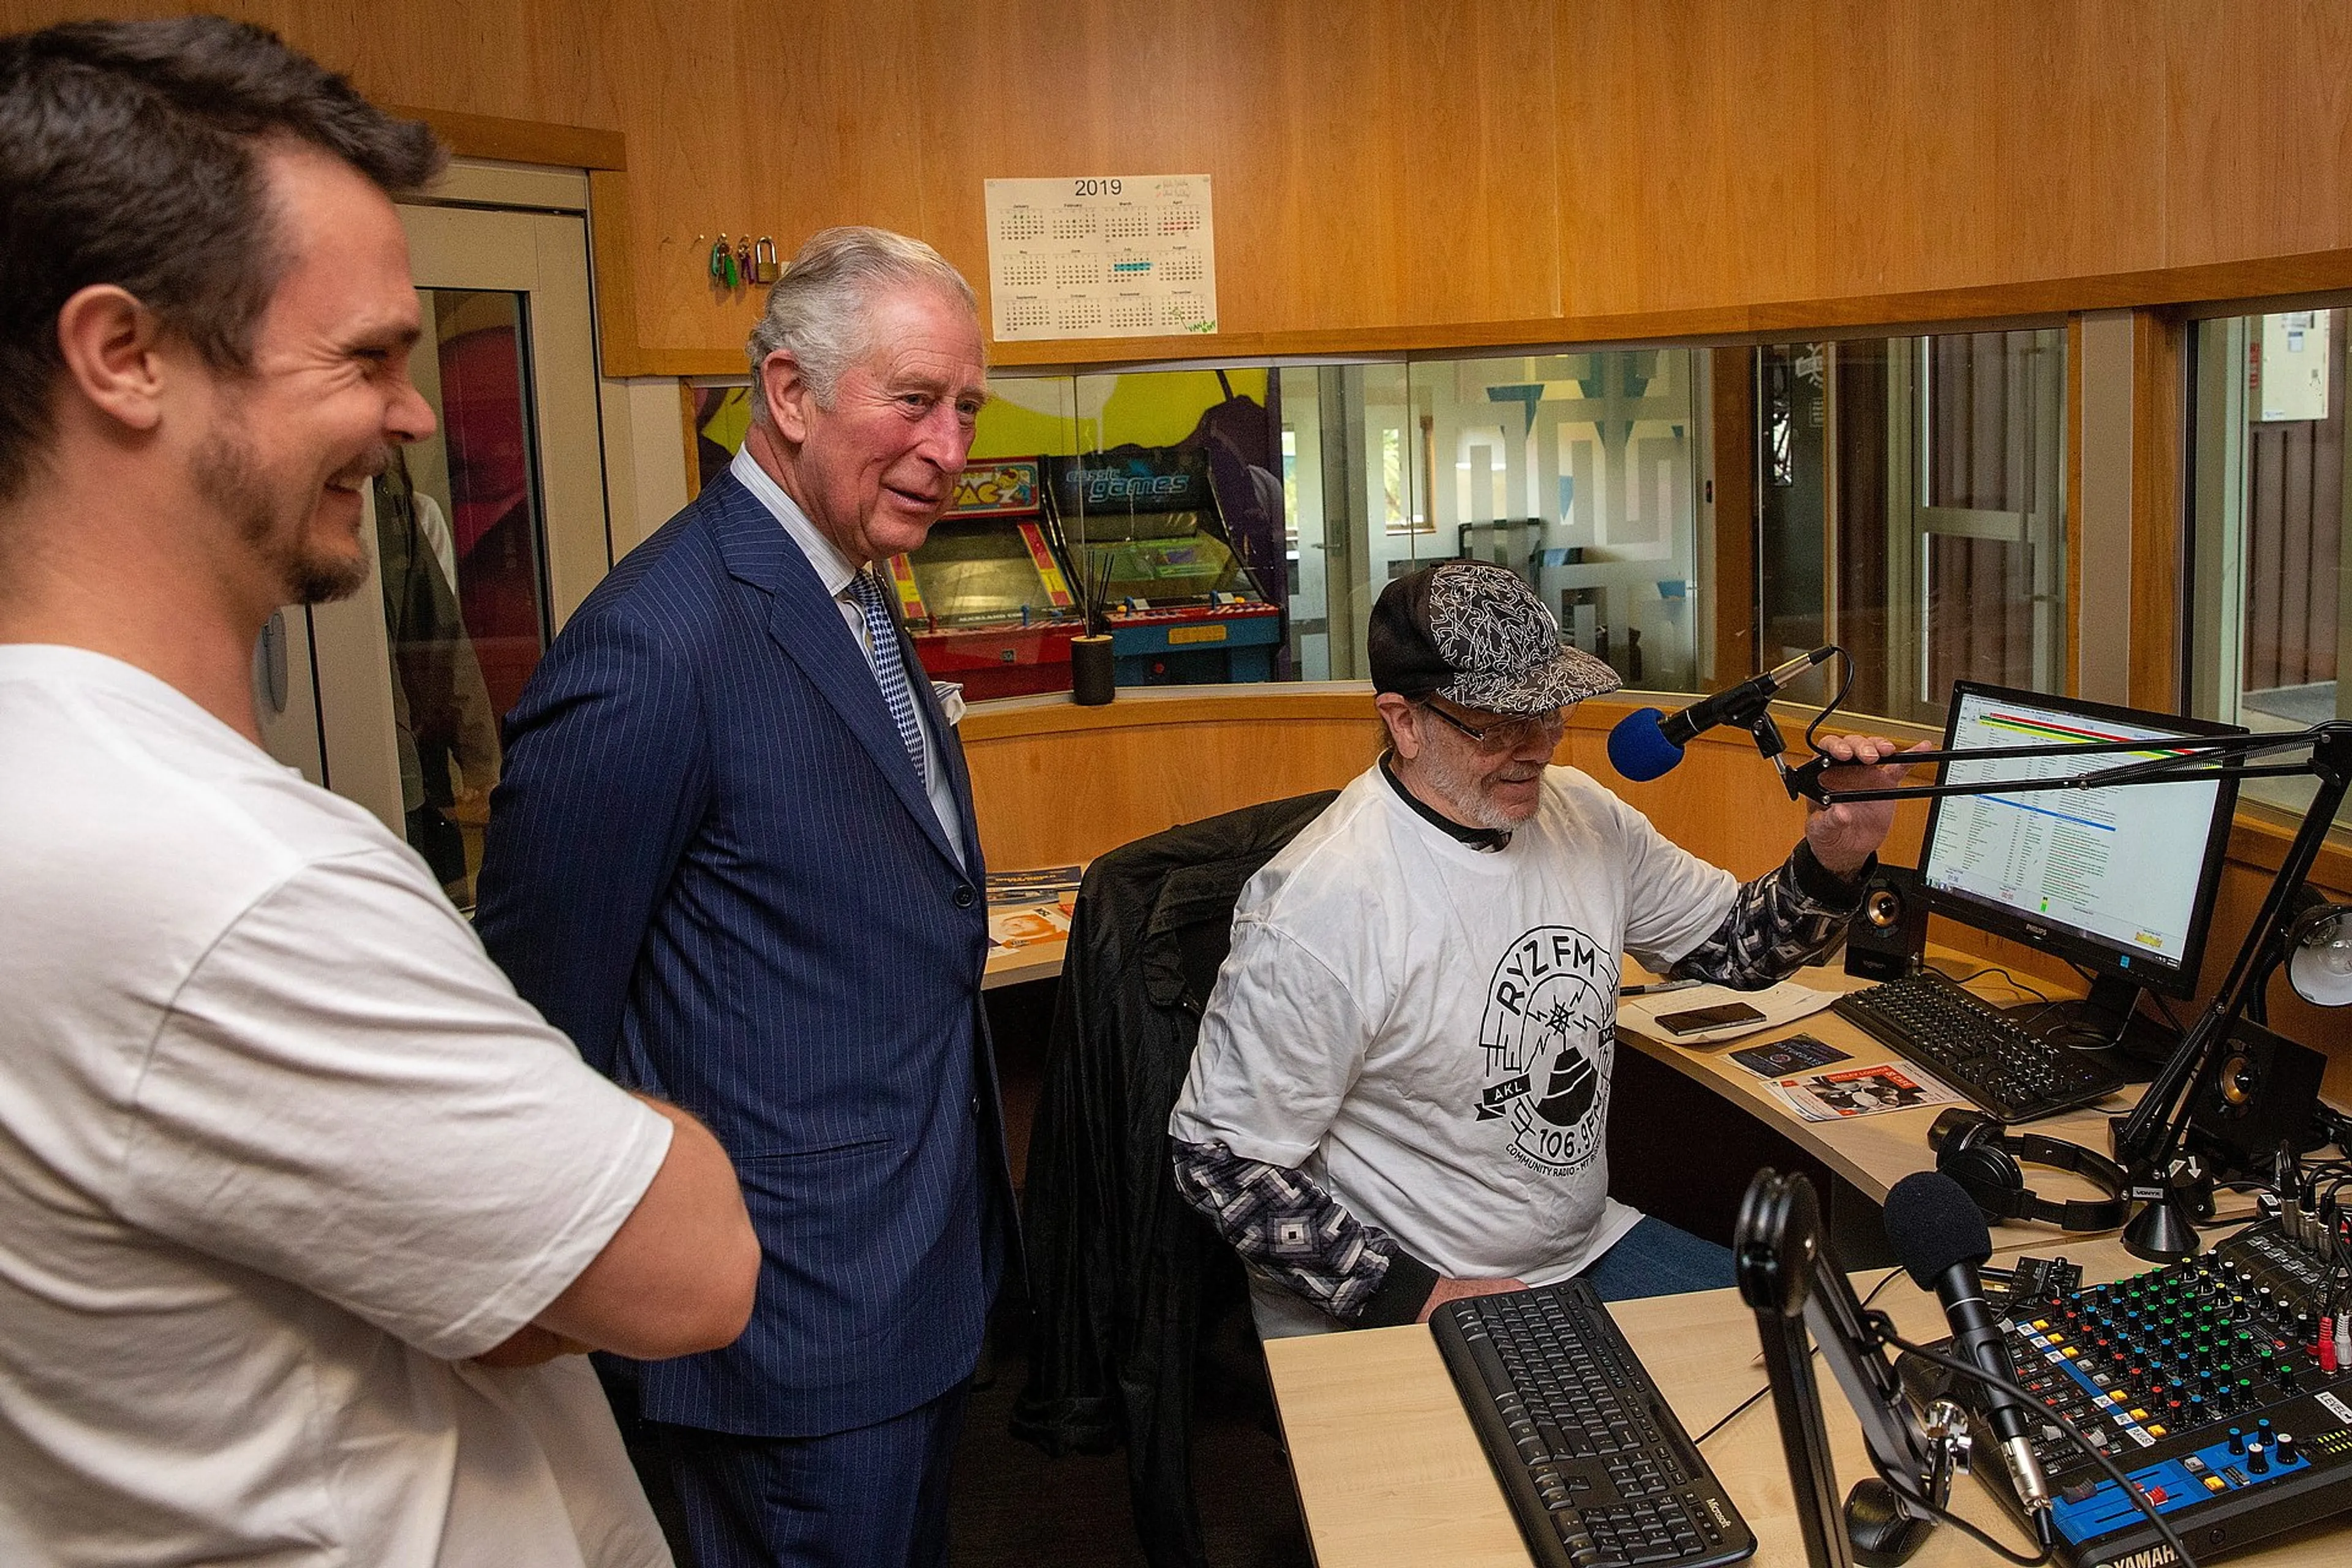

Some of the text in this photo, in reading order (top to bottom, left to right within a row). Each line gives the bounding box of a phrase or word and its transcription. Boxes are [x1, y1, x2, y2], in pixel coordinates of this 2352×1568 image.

[1075, 179, 1122, 196] 2019
[1088, 475, 1190, 503] games
[1496, 936, 1595, 1016] RYZ FM
[1494, 1082, 1522, 1101] AKL
[1506, 1143, 1551, 1175] COMMUNITY
[1553, 1166, 1575, 1177] RADIO
[2320, 1394, 2345, 1415] LEVEL
[1706, 1498, 1732, 1528] Microsoft
[2113, 1539, 2184, 1568] YAMAH
